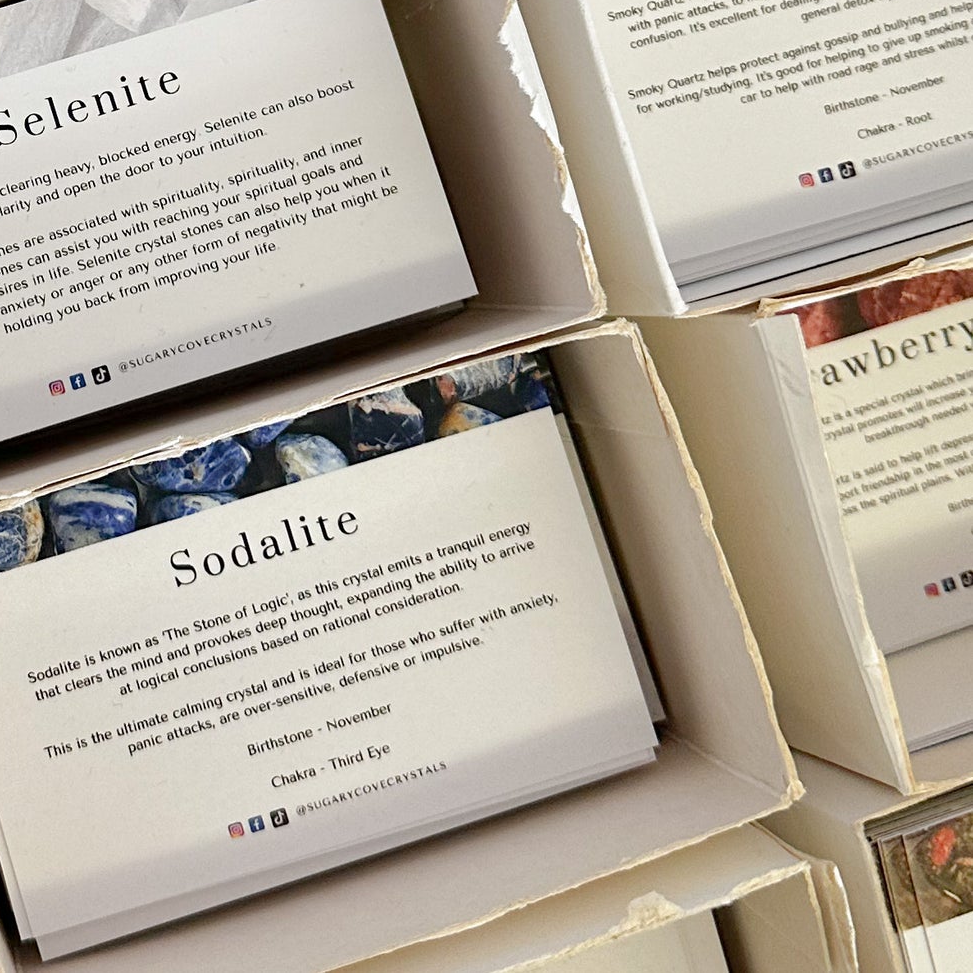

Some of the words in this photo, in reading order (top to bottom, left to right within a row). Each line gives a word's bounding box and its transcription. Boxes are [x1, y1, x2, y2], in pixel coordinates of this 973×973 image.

[800, 2, 841, 23] general
[823, 93, 879, 115] Birthstone
[889, 75, 944, 97] November
[35, 188, 60, 205] and
[63, 179, 96, 197] open
[99, 172, 120, 185] the
[124, 160, 154, 177] door
[158, 156, 173, 167] to
[176, 145, 204, 165] your
[209, 128, 266, 151] intuition.
[3, 311, 53, 334] holding
[56, 302, 81, 321] you
[83, 290, 116, 309] back
[118, 281, 150, 298] from
[152, 260, 219, 287] improving
[221, 249, 250, 269] your
[254, 241, 278, 256] life.
[118, 317, 272, 372] @SUGARYCOVECRYSTALS
[170, 511, 358, 587] Sodalite
[119, 682, 133, 695] at
[135, 667, 179, 690] logical
[182, 645, 258, 675] conclusions
[260, 629, 299, 651] based
[302, 626, 319, 638] on
[322, 607, 371, 632] rational
[374, 583, 463, 616] consideration.
[127, 734, 163, 757] panic
[166, 719, 215, 741] attacks,
[219, 711, 240, 724] are
[243, 682, 335, 717] over-sensitive,
[338, 661, 399, 687] defensive
[403, 655, 416, 667] or
[420, 636, 483, 662] impulsive.
[246, 728, 313, 756] Birthstone
[325, 703, 390, 731] November
[295, 761, 446, 816] @SUGARYCOVECRYSTALS
